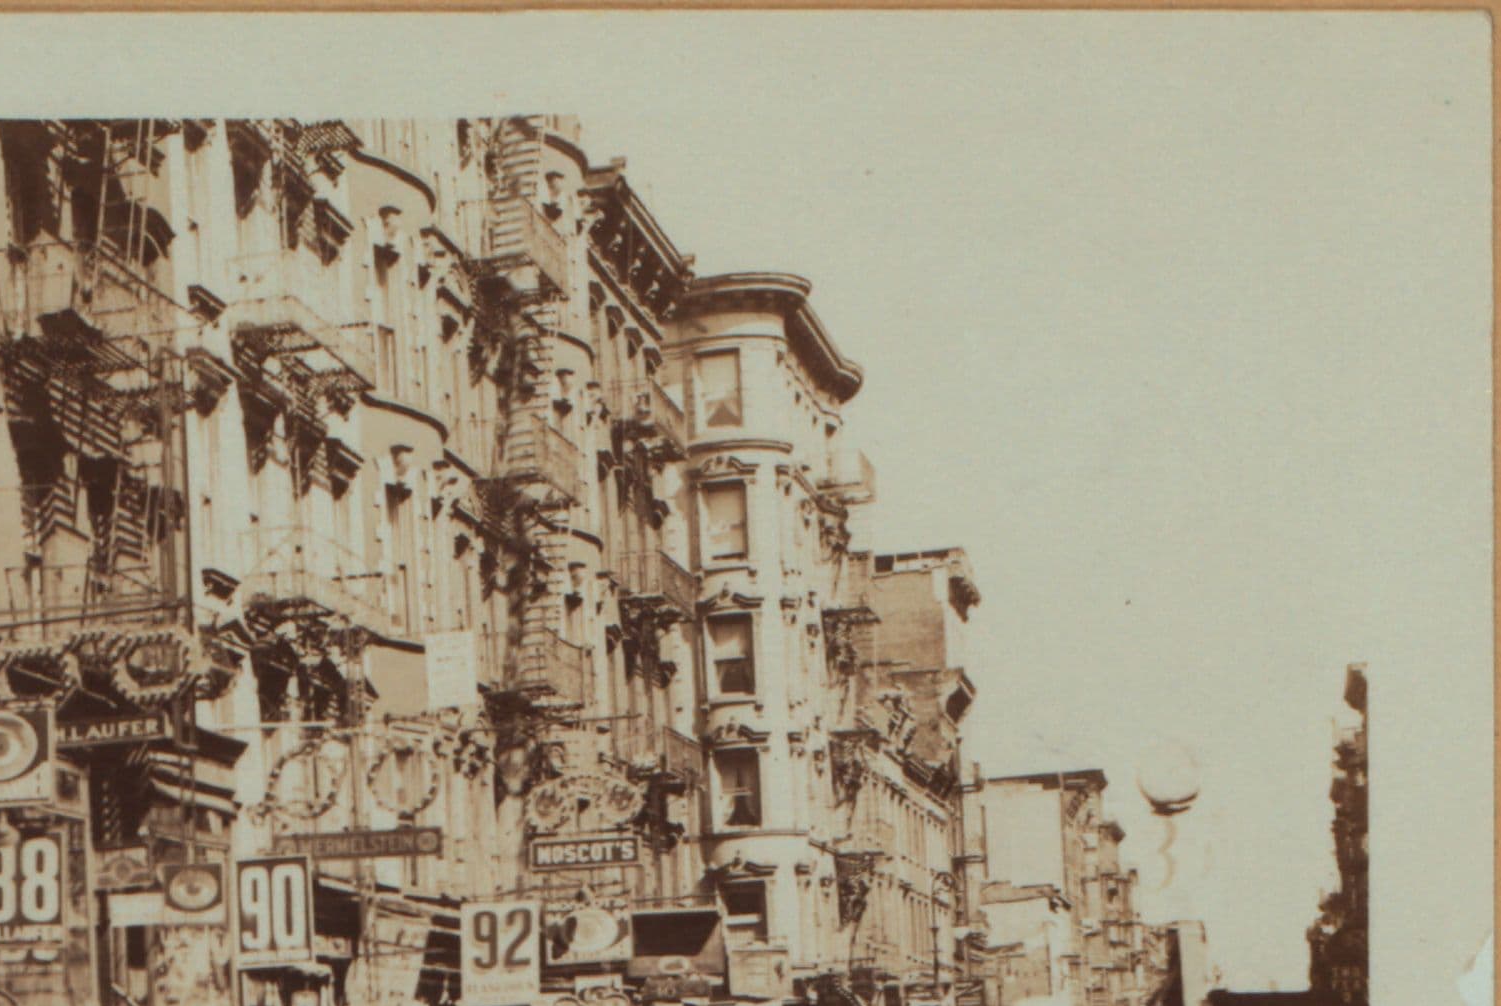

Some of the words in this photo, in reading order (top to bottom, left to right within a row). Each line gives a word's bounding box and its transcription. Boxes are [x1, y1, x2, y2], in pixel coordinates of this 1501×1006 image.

[537, 841, 635, 865] MOSCOT'S
[240, 863, 304, 950] 90
[473, 908, 533, 969] 92
